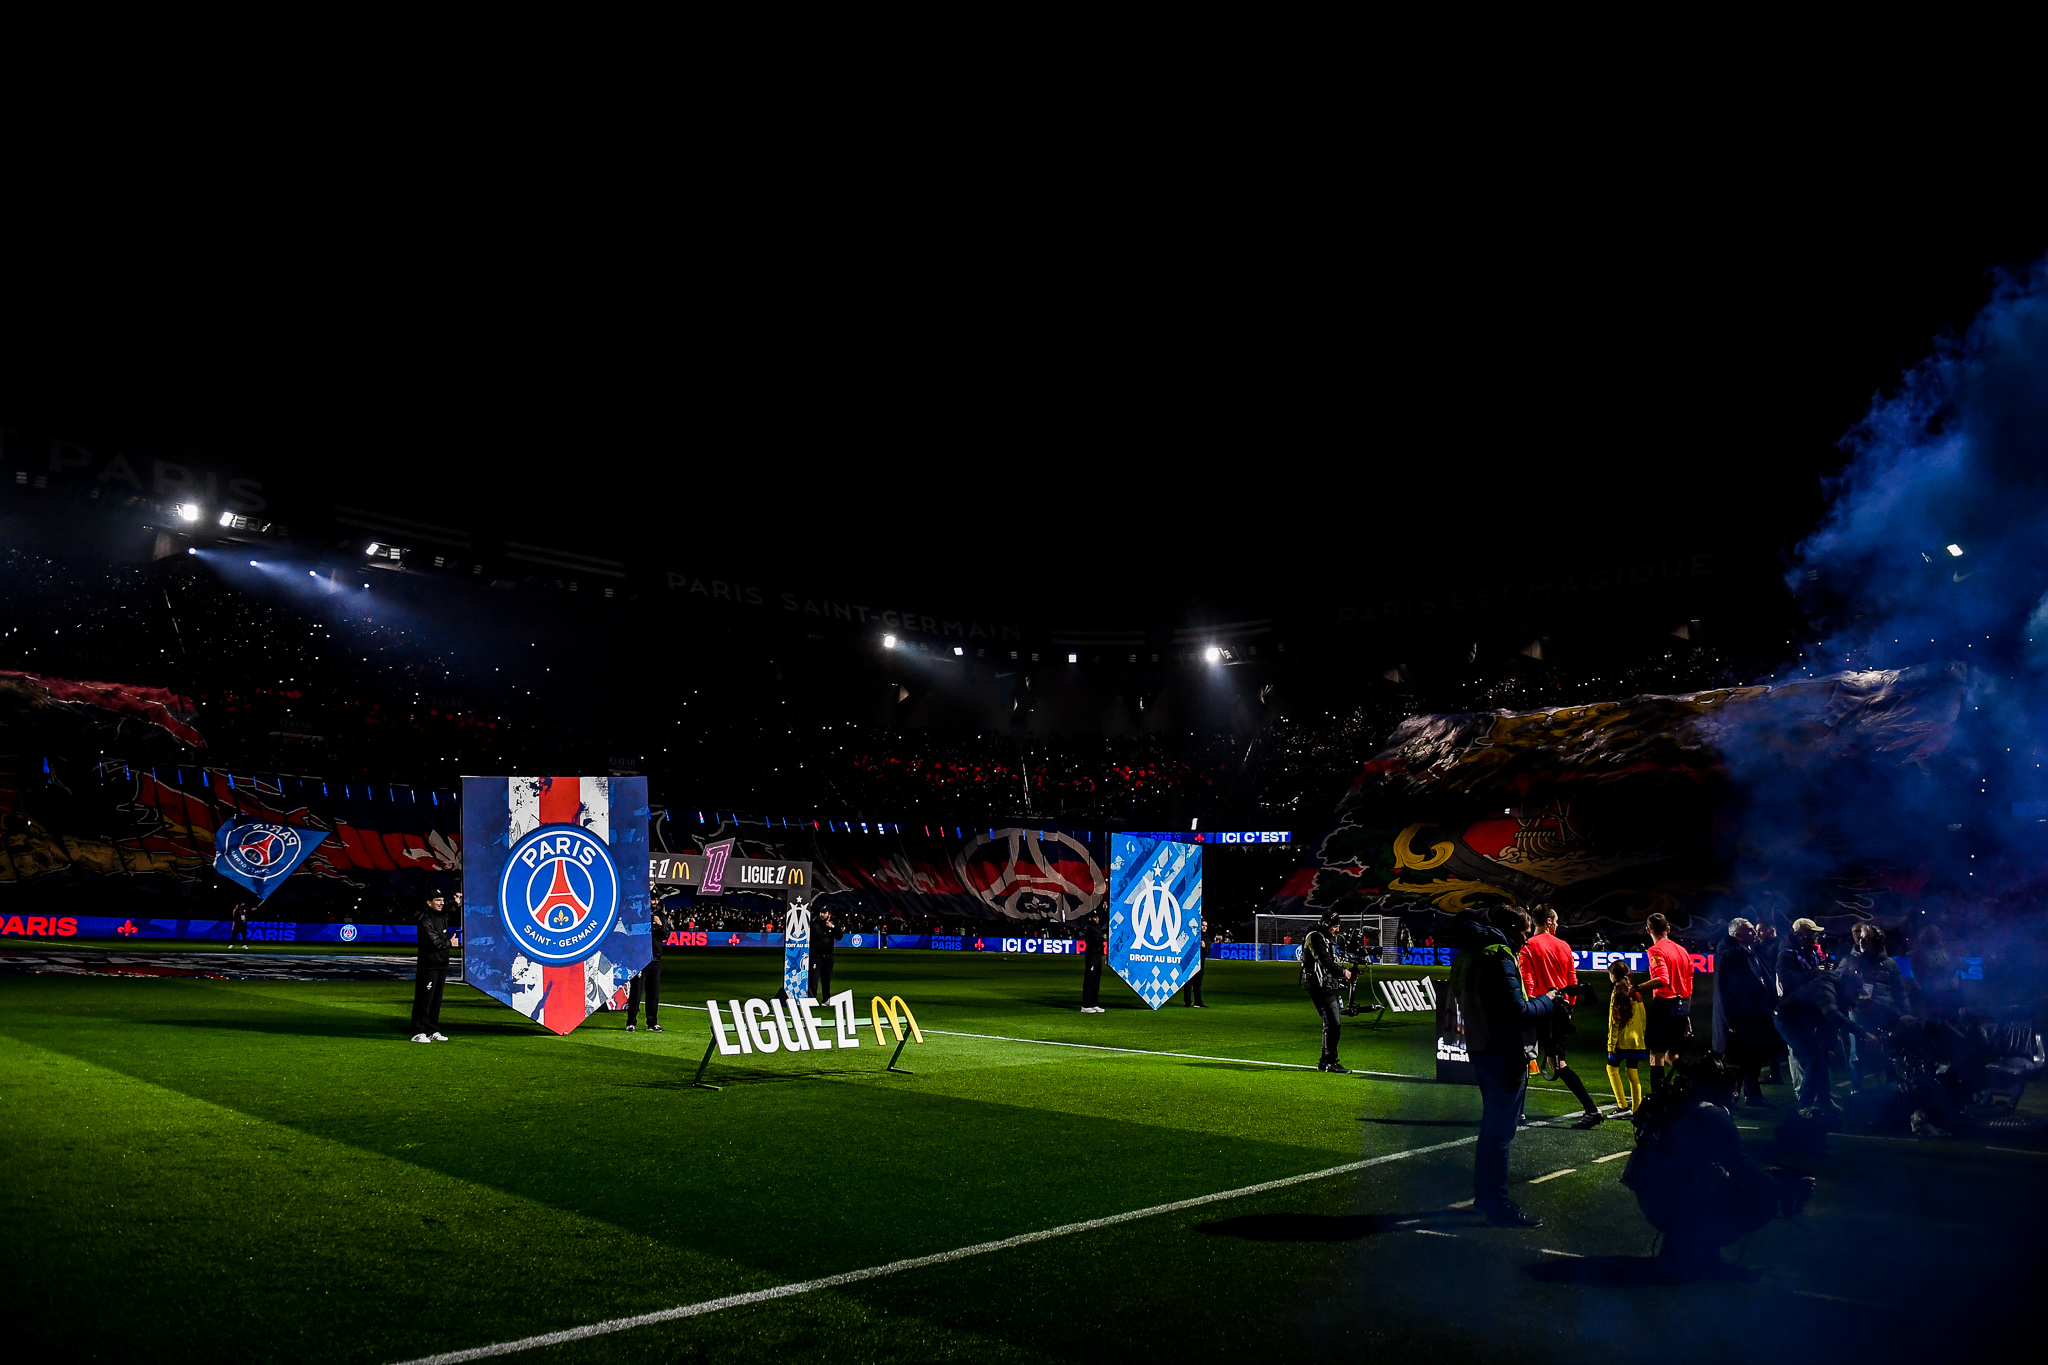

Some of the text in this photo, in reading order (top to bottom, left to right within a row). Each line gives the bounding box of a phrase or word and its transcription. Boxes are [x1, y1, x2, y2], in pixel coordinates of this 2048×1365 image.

[49, 435, 268, 513] PARIS
[1336, 552, 1713, 626] PARIS EST MAGIQUE
[665, 569, 1023, 641] PARIS SAINT-GERMAIN
[1222, 832, 1288, 843] ICI C'EST
[521, 836, 597, 869] PARIS
[0, 915, 79, 937] ARIS
[524, 924, 552, 946] SAINT
[558, 919, 598, 948] GERMAIN
[665, 931, 708, 946] ARIS
[931, 941, 962, 951] PARIS
[1002, 937, 1021, 952] ICI
[1025, 938, 1073, 955] C'EST
[1129, 953, 1182, 964] DROIT AU BUT
[1402, 954, 1451, 967] PARS
